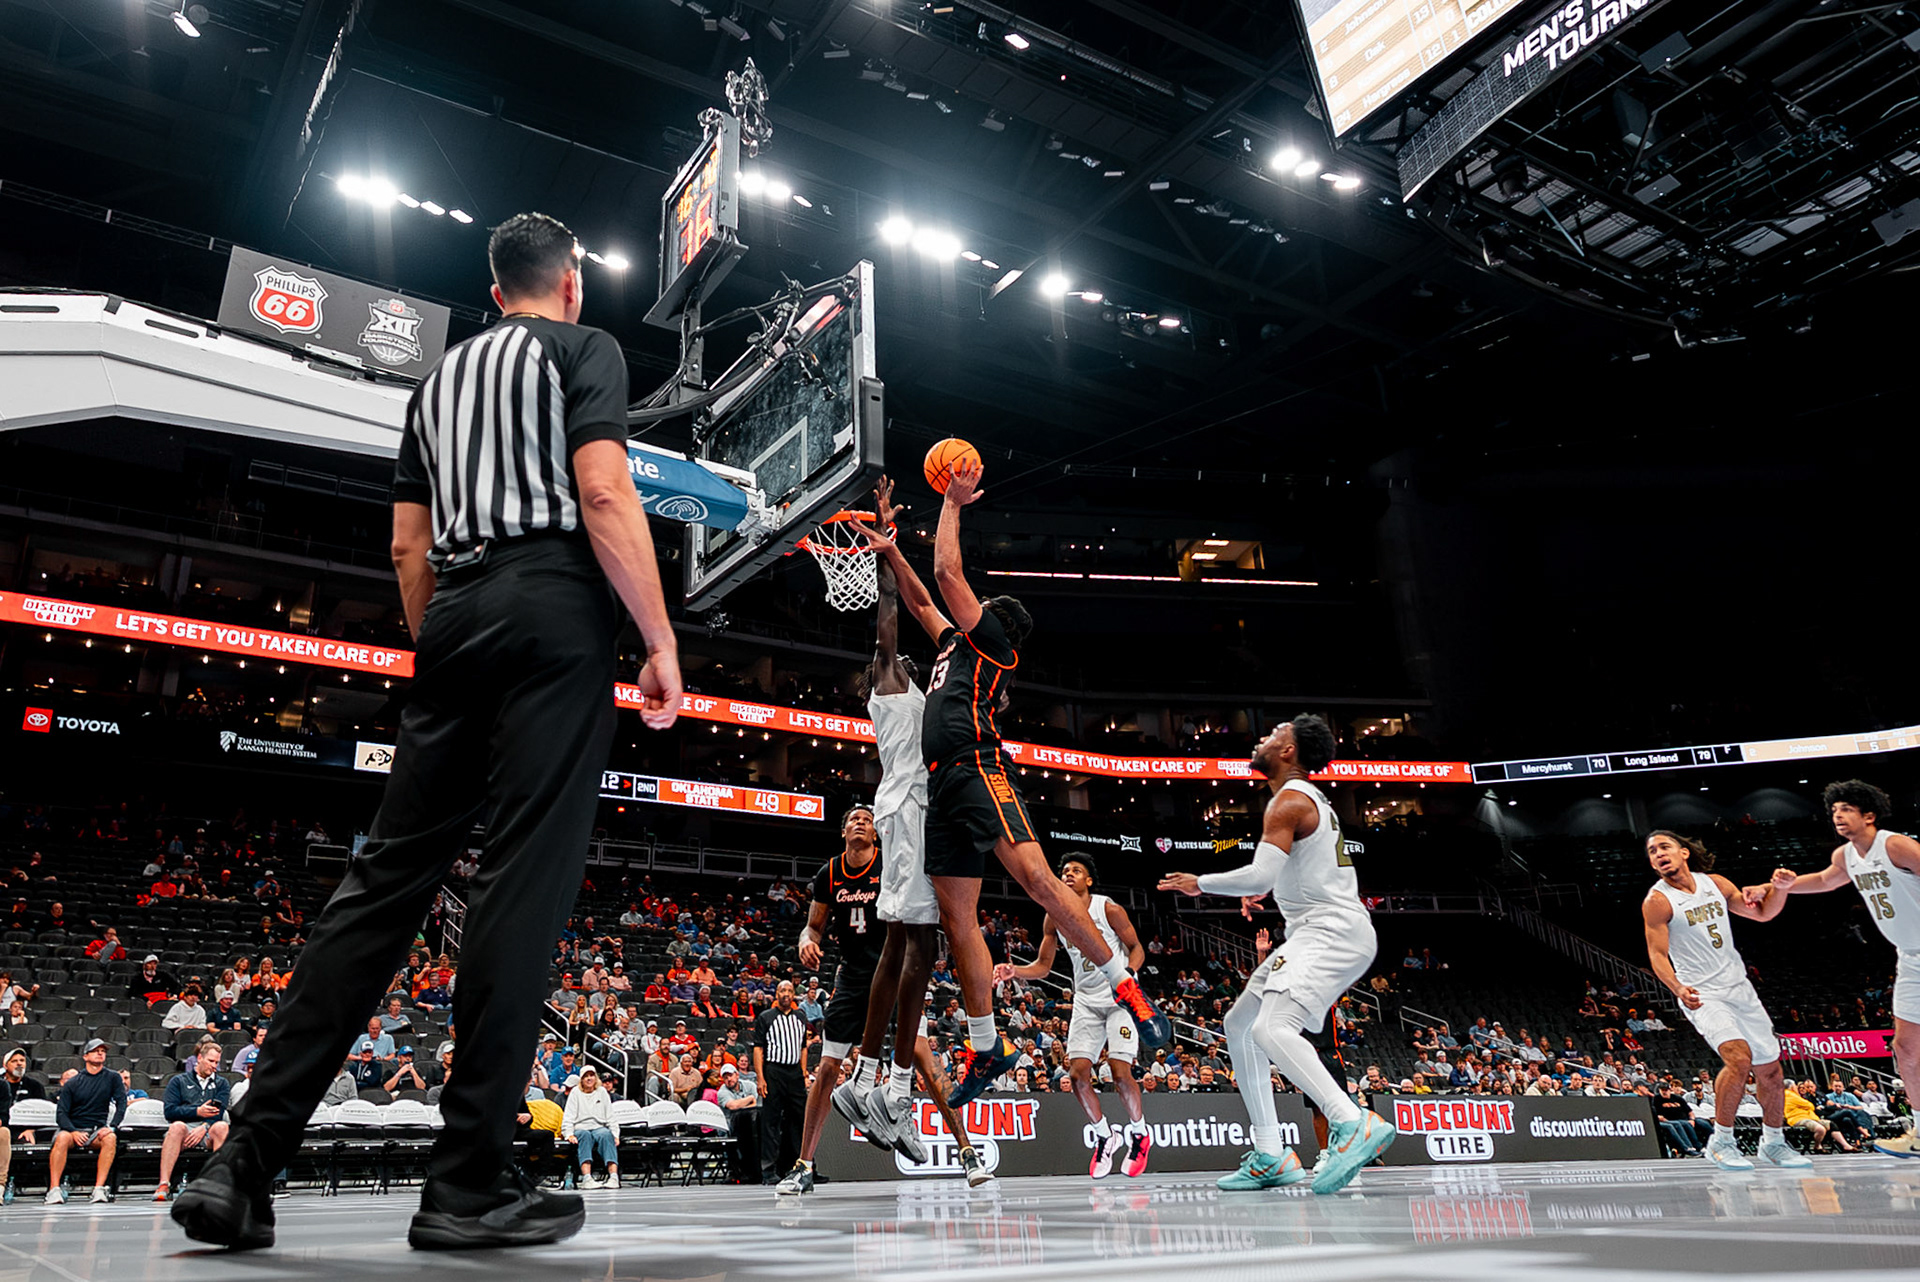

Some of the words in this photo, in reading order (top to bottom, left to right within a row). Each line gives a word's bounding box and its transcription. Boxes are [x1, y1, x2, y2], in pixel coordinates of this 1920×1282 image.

[1503, 0, 1585, 77] MEN'S
[266, 275, 316, 298] PHILLIPS
[263, 294, 309, 322] 66
[23, 599, 95, 618] DISCOUNT
[116, 613, 168, 635] LET'S
[172, 622, 211, 641] GET
[215, 627, 254, 647] YOU
[258, 634, 319, 657] TAKEN
[323, 644, 369, 664] CARE
[57, 716, 120, 735] TOYOTA
[789, 712, 823, 729] LET'S
[825, 719, 850, 733] GET
[1870, 742, 1880, 751] 5
[1034, 748, 1062, 762] LET'S
[1064, 753, 1084, 766] GET
[1086, 756, 1109, 769] YOU
[1110, 759, 1151, 773] TAKEN
[1151, 761, 1184, 773] CARE
[1522, 762, 1574, 775] Mercyhurst
[1592, 759, 1606, 768] 70
[1625, 756, 1648, 767] Long
[1649, 753, 1679, 764] Island
[1331, 763, 1359, 776] YOU
[1360, 764, 1401, 777] TAKEN
[1401, 764, 1433, 777] CARE
[637, 782, 656, 793] 2ND
[671, 782, 733, 799] OKLAHOMA
[685, 794, 719, 807] STATE
[755, 793, 779, 812] 49
[1174, 841, 1198, 849] TASTES
[1199, 841, 1213, 849] LIKE
[1212, 838, 1243, 854] Miller
[1855, 870, 1891, 892] BUFFS
[836, 888, 876, 903] Cowboys
[1685, 901, 1724, 927] BUFFS
[1870, 893, 1895, 920] 15
[850, 907, 866, 934] 4
[1707, 924, 1723, 949] 5
[1395, 1100, 1513, 1133] DISCOUNT
[1530, 1116, 1646, 1138] discounttire.com
[1434, 1137, 1486, 1155] TIRE
